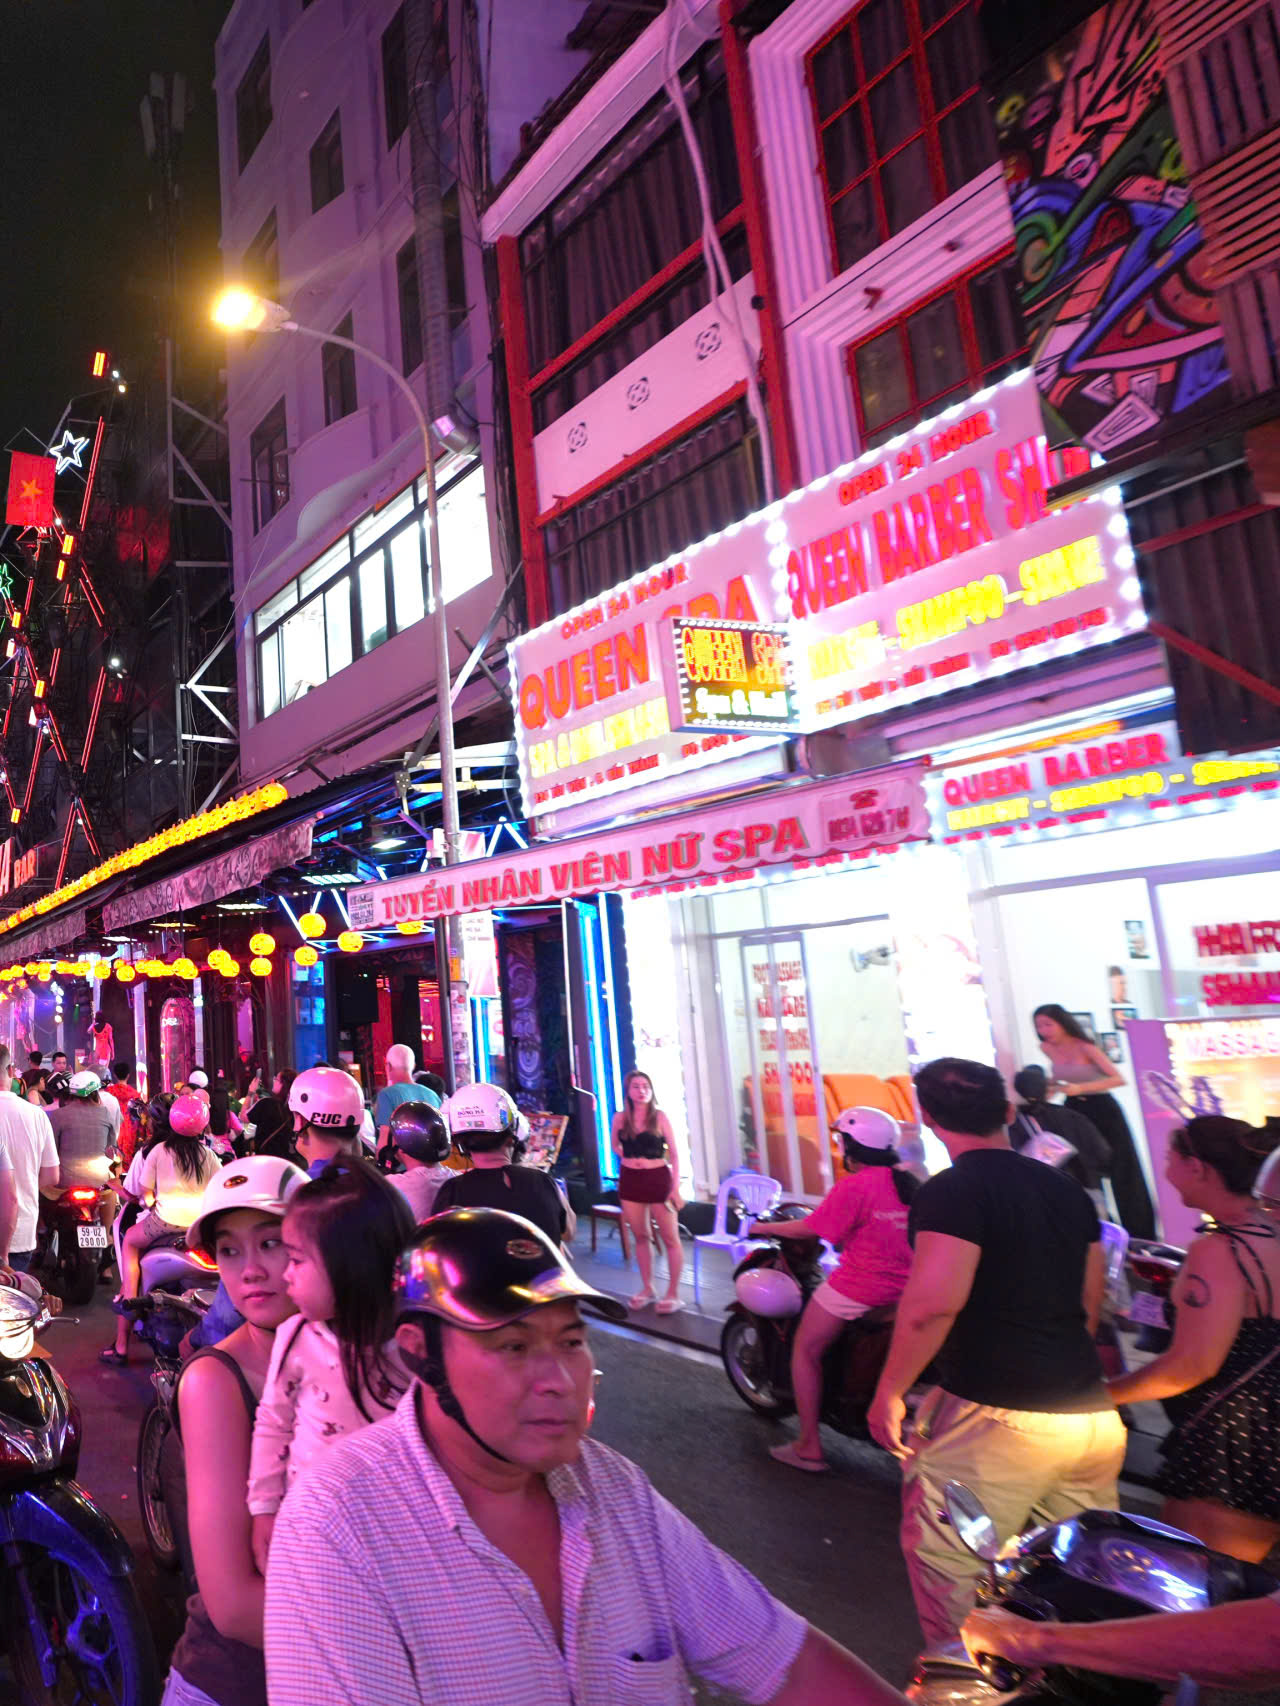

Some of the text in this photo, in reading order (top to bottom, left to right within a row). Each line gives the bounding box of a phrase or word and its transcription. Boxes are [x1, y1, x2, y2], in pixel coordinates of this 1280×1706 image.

[839, 462, 887, 505] OPEN
[929, 410, 994, 461] HOUR
[787, 520, 870, 620] QUEEN
[872, 467, 993, 584] BARBER
[560, 605, 604, 640] OPEN
[635, 562, 689, 604] HOUR
[520, 622, 651, 730] QUEEN
[943, 761, 1032, 807] QUEEN
[1043, 733, 1171, 786] BARBER
[14, 847, 37, 889] BAR
[382, 878, 456, 920] TUYỂN
[462, 867, 542, 907] NHÂN
[550, 851, 631, 892] VIÊN
[641, 832, 703, 877] NỮ
[712, 816, 809, 863] SPA
